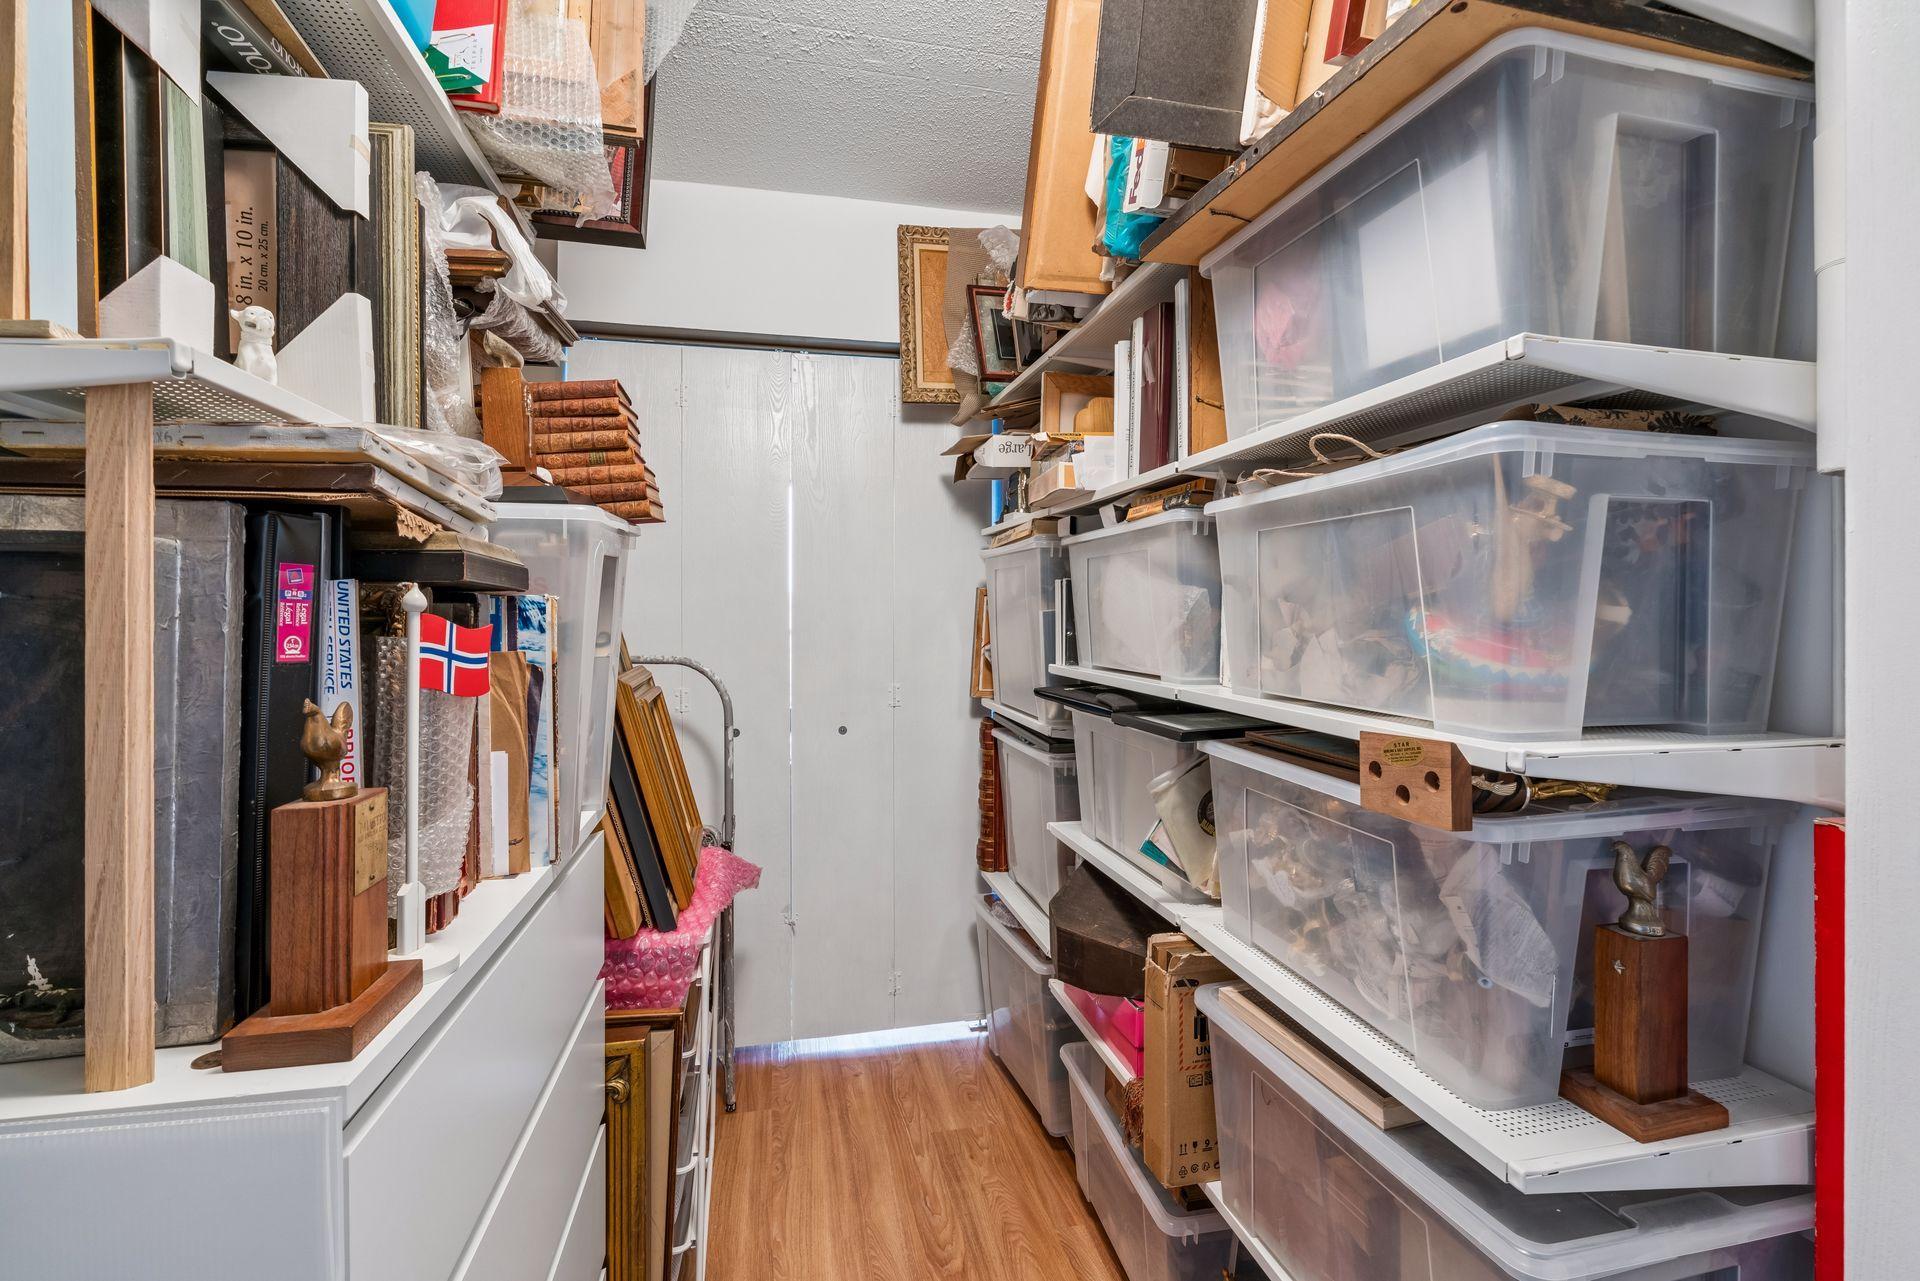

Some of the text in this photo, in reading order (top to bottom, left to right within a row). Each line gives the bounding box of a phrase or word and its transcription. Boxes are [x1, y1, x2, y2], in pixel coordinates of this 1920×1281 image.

[260, 220, 269, 236] cm.
[258, 238, 269, 251] 25
[235, 206, 253, 306] 8 in. x 10 in.
[260, 262, 269, 278] cm.
[258, 280, 268, 292] 20
[998, 440, 1032, 456] Large
[301, 603, 309, 625] Legal
[337, 581, 353, 689] UNITED STATES
